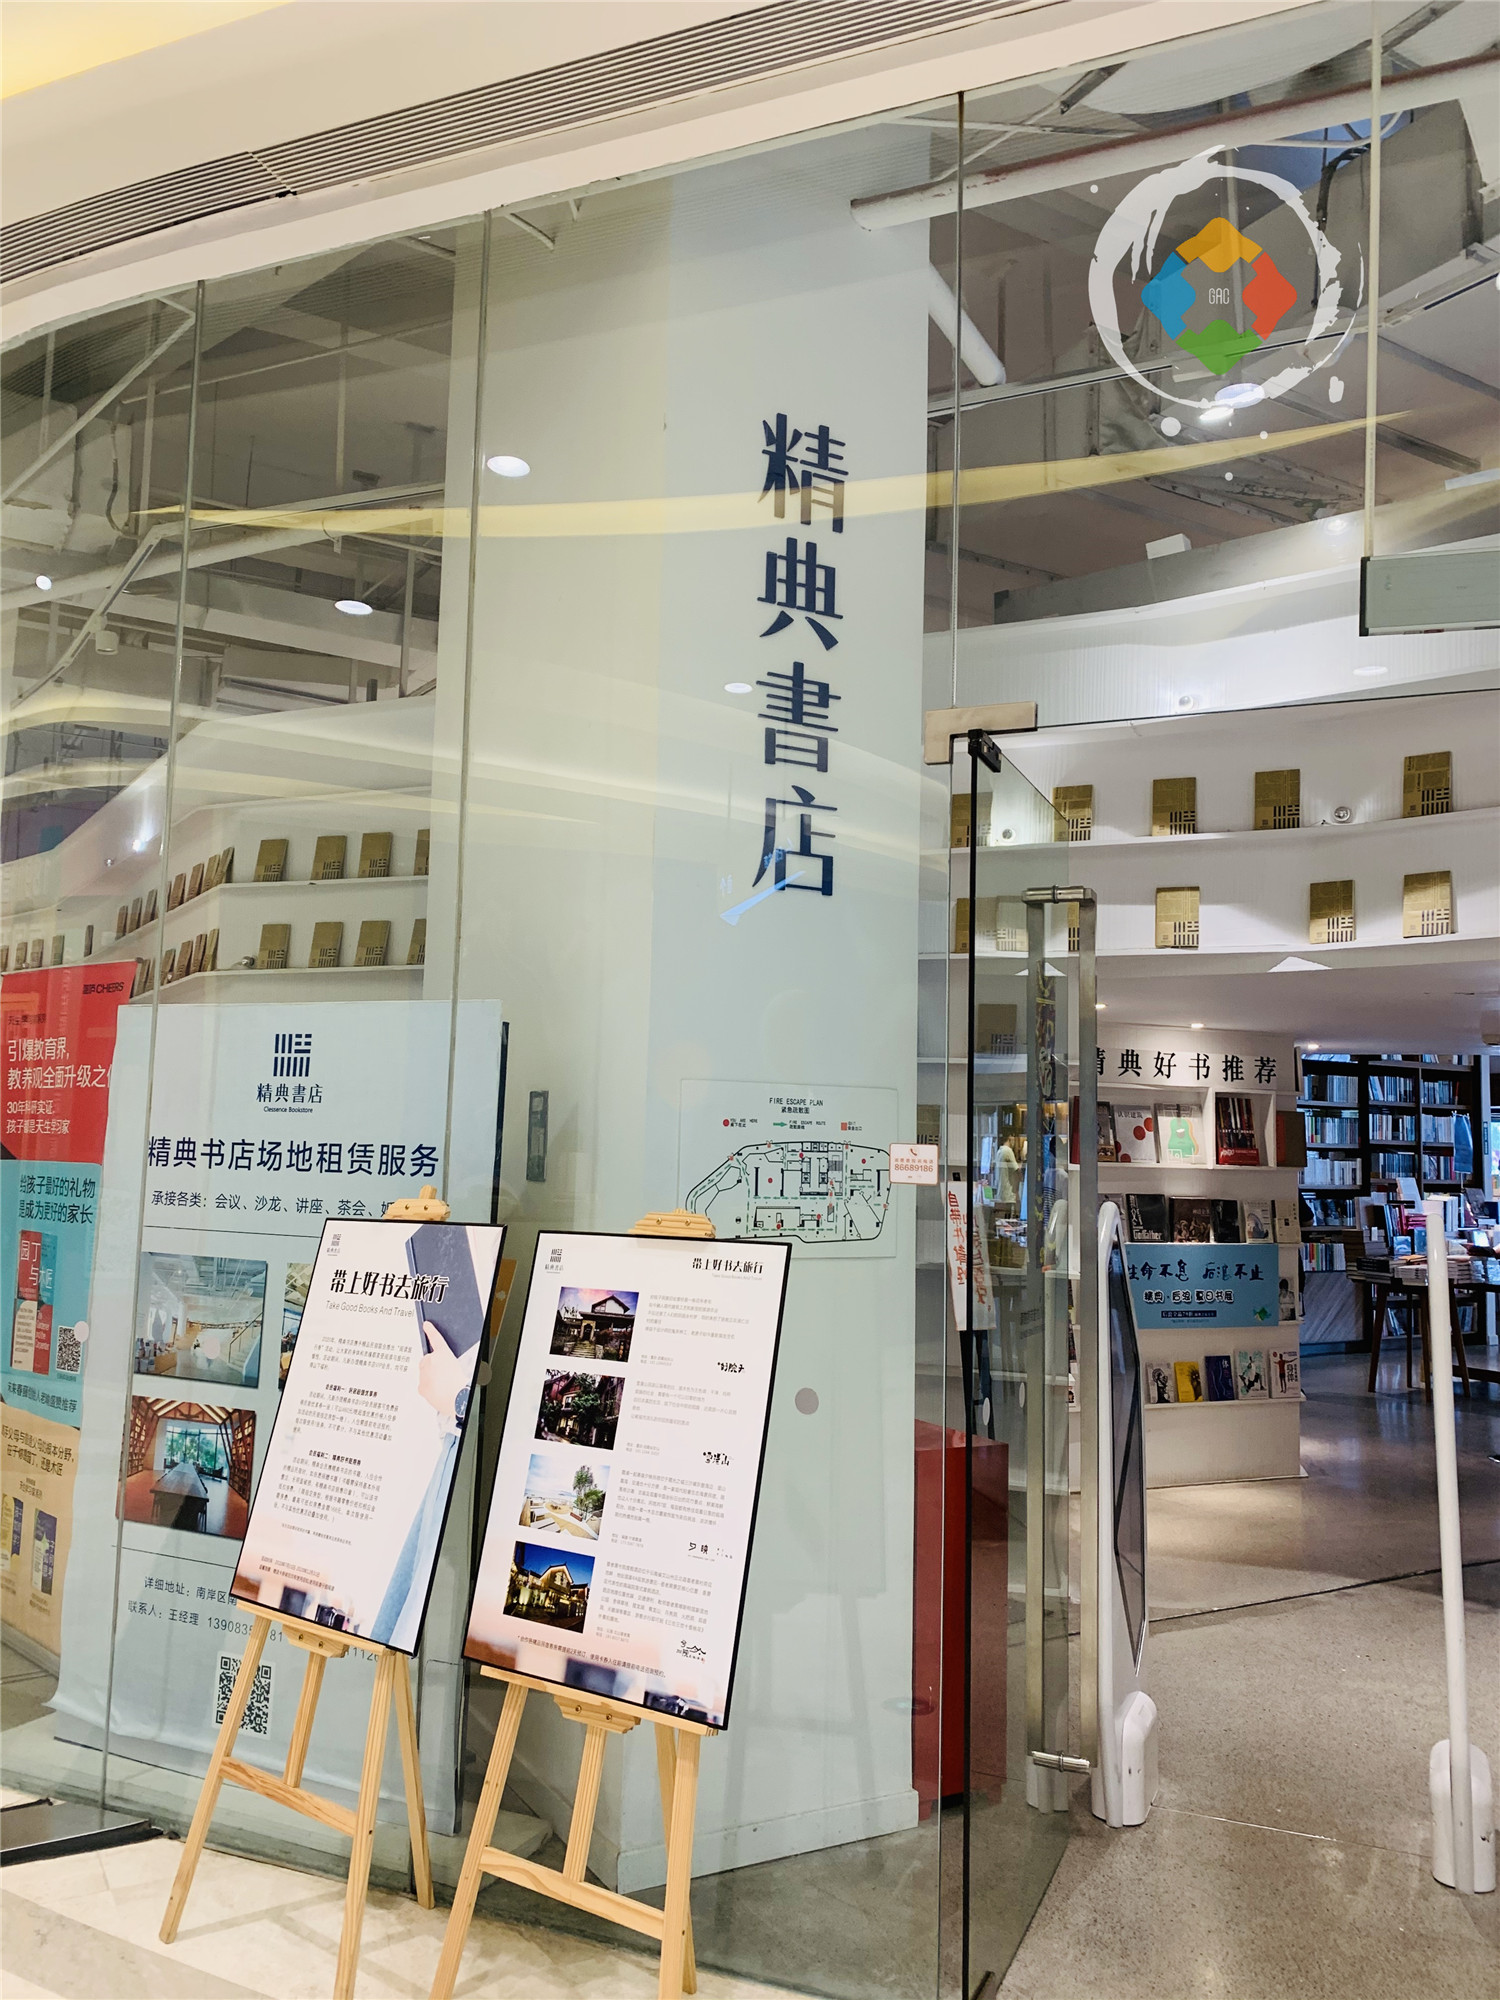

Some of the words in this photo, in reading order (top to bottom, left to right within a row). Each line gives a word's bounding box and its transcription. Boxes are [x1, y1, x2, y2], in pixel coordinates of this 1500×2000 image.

[752, 412, 848, 896] 精典書店
[96, 982, 125, 994] CHEERS
[256, 1083, 323, 1105] 精典書店
[769, 1097, 783, 1105] FIRE
[786, 1098, 808, 1106] ESCAPE
[809, 1099, 824, 1107] PLAN
[288, 1106, 314, 1114] Bookstore
[147, 1137, 440, 1178] 精典书店场地租赁服务
[894, 1163, 934, 1173] 86689186
[19, 1174, 96, 1199] 给孩子最好的礼物
[18, 1200, 94, 1225] 是成为更好的家长
[692, 1258, 764, 1274] 带上好书去旅行
[330, 1269, 449, 1303] 带上好书去旅行
[326, 1300, 340, 1310] Take
[341, 1302, 357, 1312] Good
[359, 1304, 378, 1314] Books
[379, 1306, 392, 1316] And
[394, 1307, 415, 1318] Travel
[128, 1600, 200, 1626] 联系人：王经理
